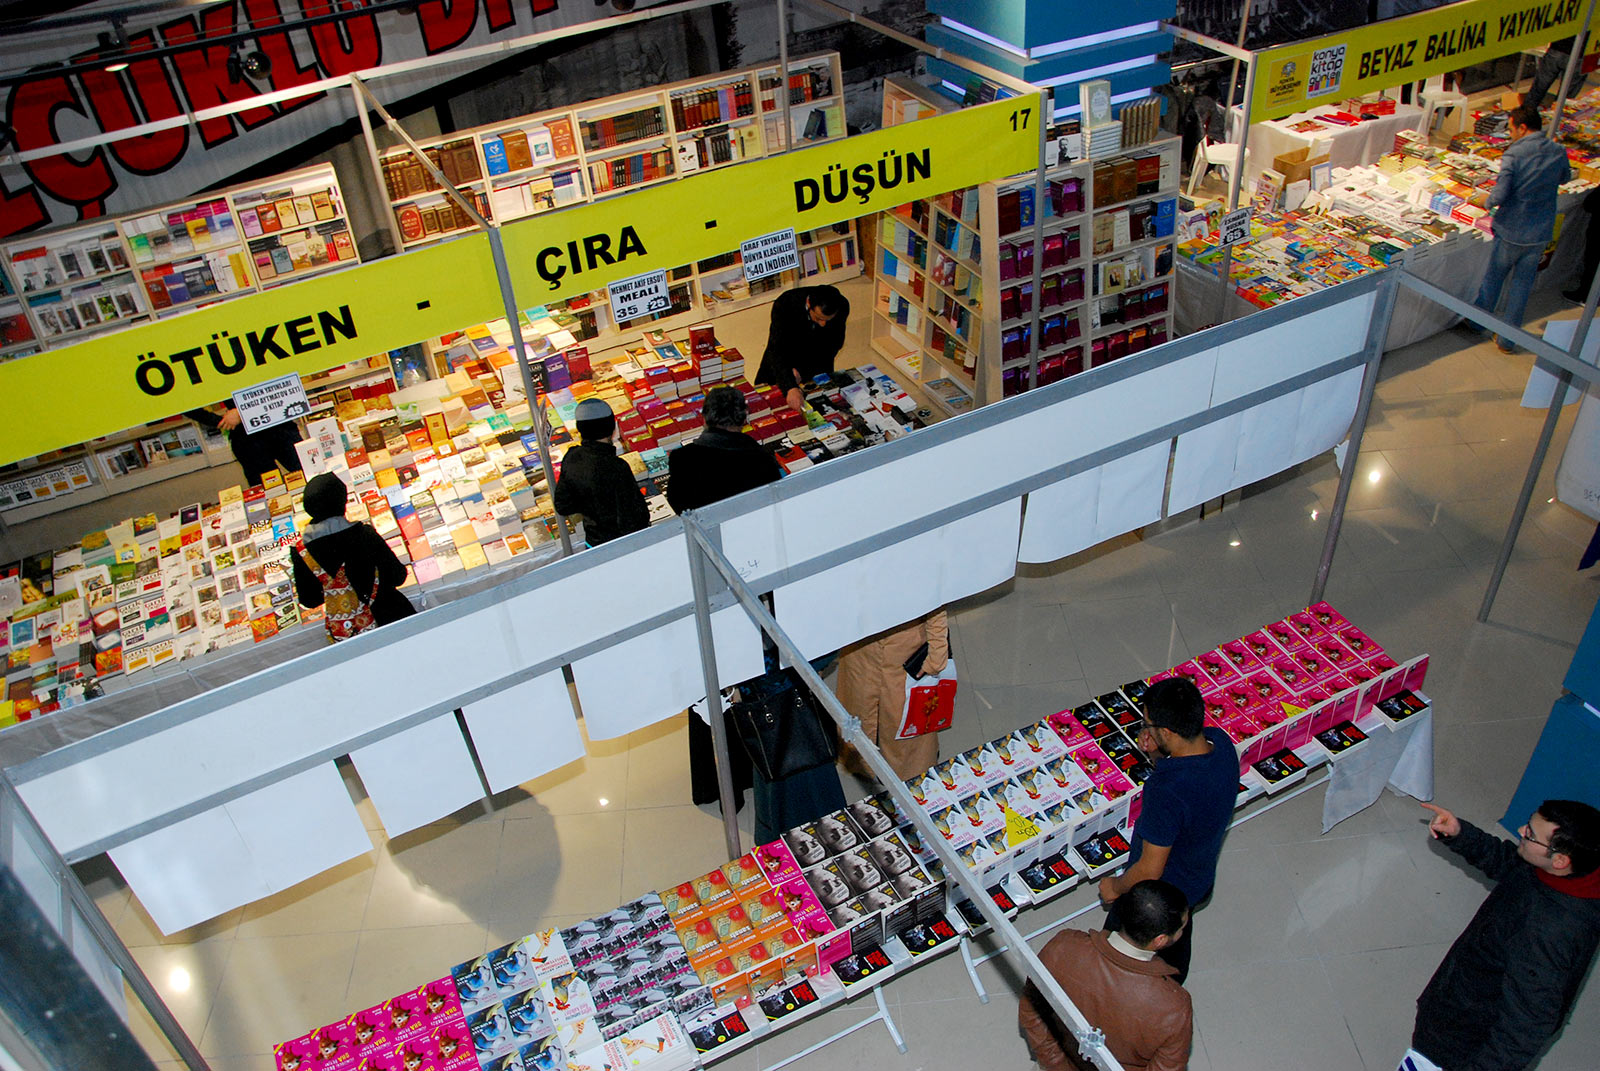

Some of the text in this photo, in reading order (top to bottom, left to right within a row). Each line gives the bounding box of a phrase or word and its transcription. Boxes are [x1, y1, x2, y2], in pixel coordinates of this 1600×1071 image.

[1358, 0, 1582, 80] BEYAZ BALİNA YAYINLARI
[1312, 45, 1345, 62] konya
[1310, 58, 1343, 75] kitap
[760, 231, 792, 247] YAYINLARI
[135, 304, 358, 396] ÖTÜKEN
[535, 225, 649, 291] ÇIRA
[793, 147, 932, 216] DÜŞÜN
[1009, 107, 1032, 132] 17
[746, 253, 796, 277] %40 İNDİRİM
[610, 274, 664, 296] MEHMET AKİF ERSOY
[619, 285, 660, 304] MEALİ
[616, 297, 666, 319] 35 25
[242, 379, 293, 401] ÖTÜKEN YAYINLARI
[260, 389, 288, 404] AYTMATOV
[249, 404, 305, 428] 65 45
